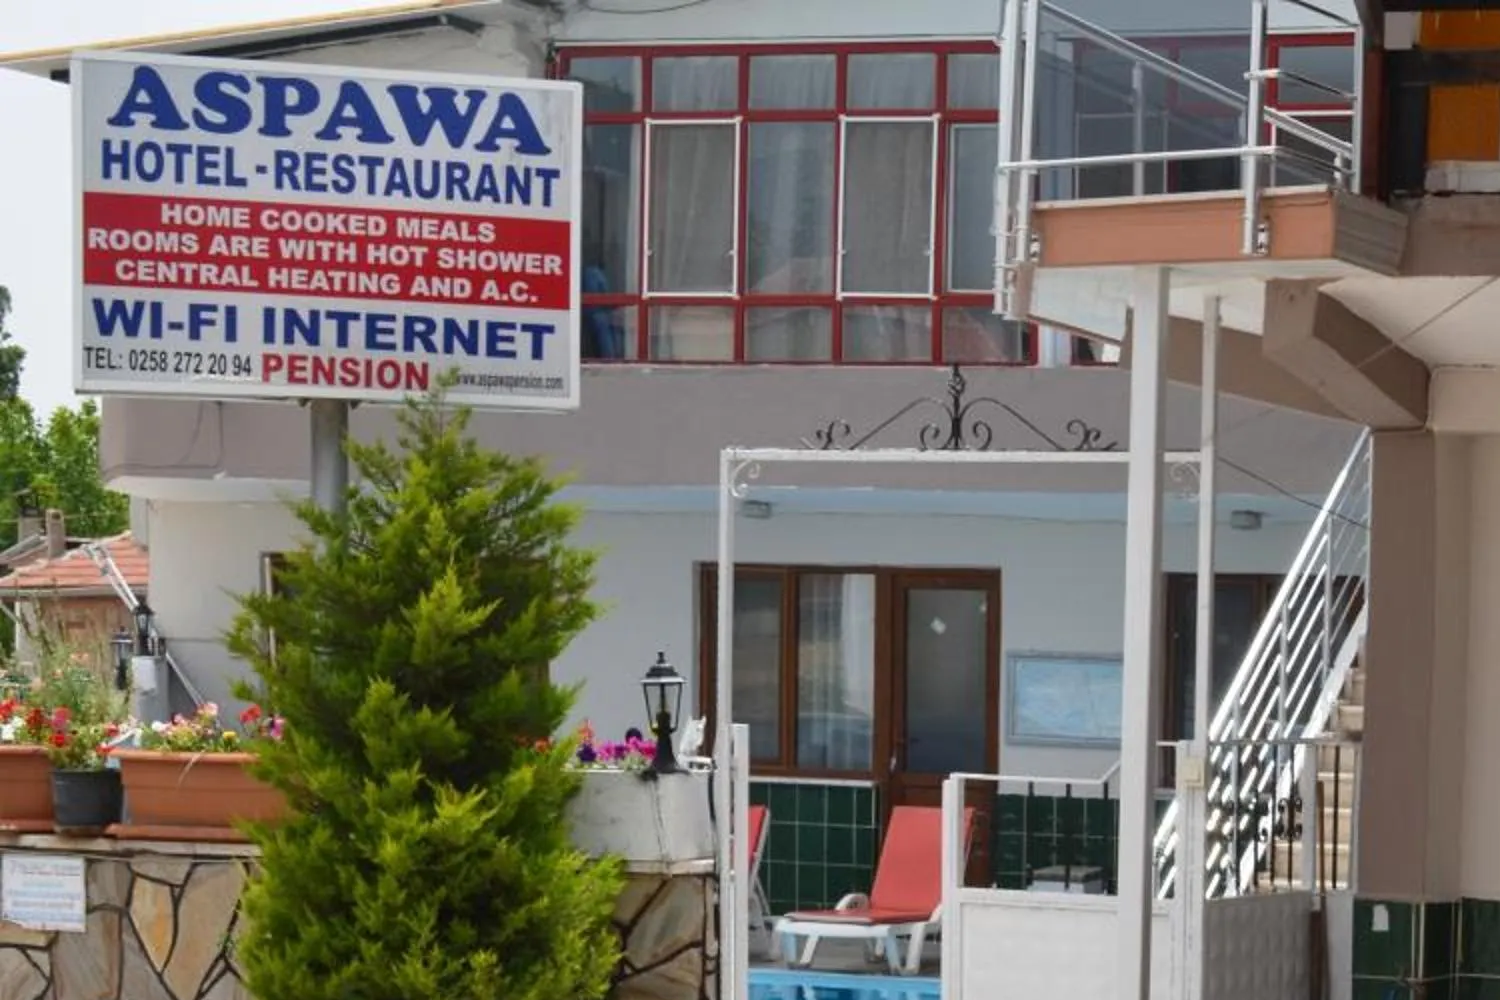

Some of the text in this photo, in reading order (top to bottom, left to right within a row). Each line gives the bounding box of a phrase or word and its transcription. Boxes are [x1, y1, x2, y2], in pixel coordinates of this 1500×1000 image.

[107, 65, 552, 156] ASPAWA
[161, 203, 496, 243] HOME COOKED MEALS
[88, 228, 563, 275] ROOMS ARE WITH HOT SHOWER
[115, 259, 539, 303] CENTRAL HEATING AND A.C.
[92, 298, 556, 361] WI-FI INTERNET
[83, 346, 253, 376] TEL: 0258 272 20 94
[261, 353, 429, 391] PENSION
